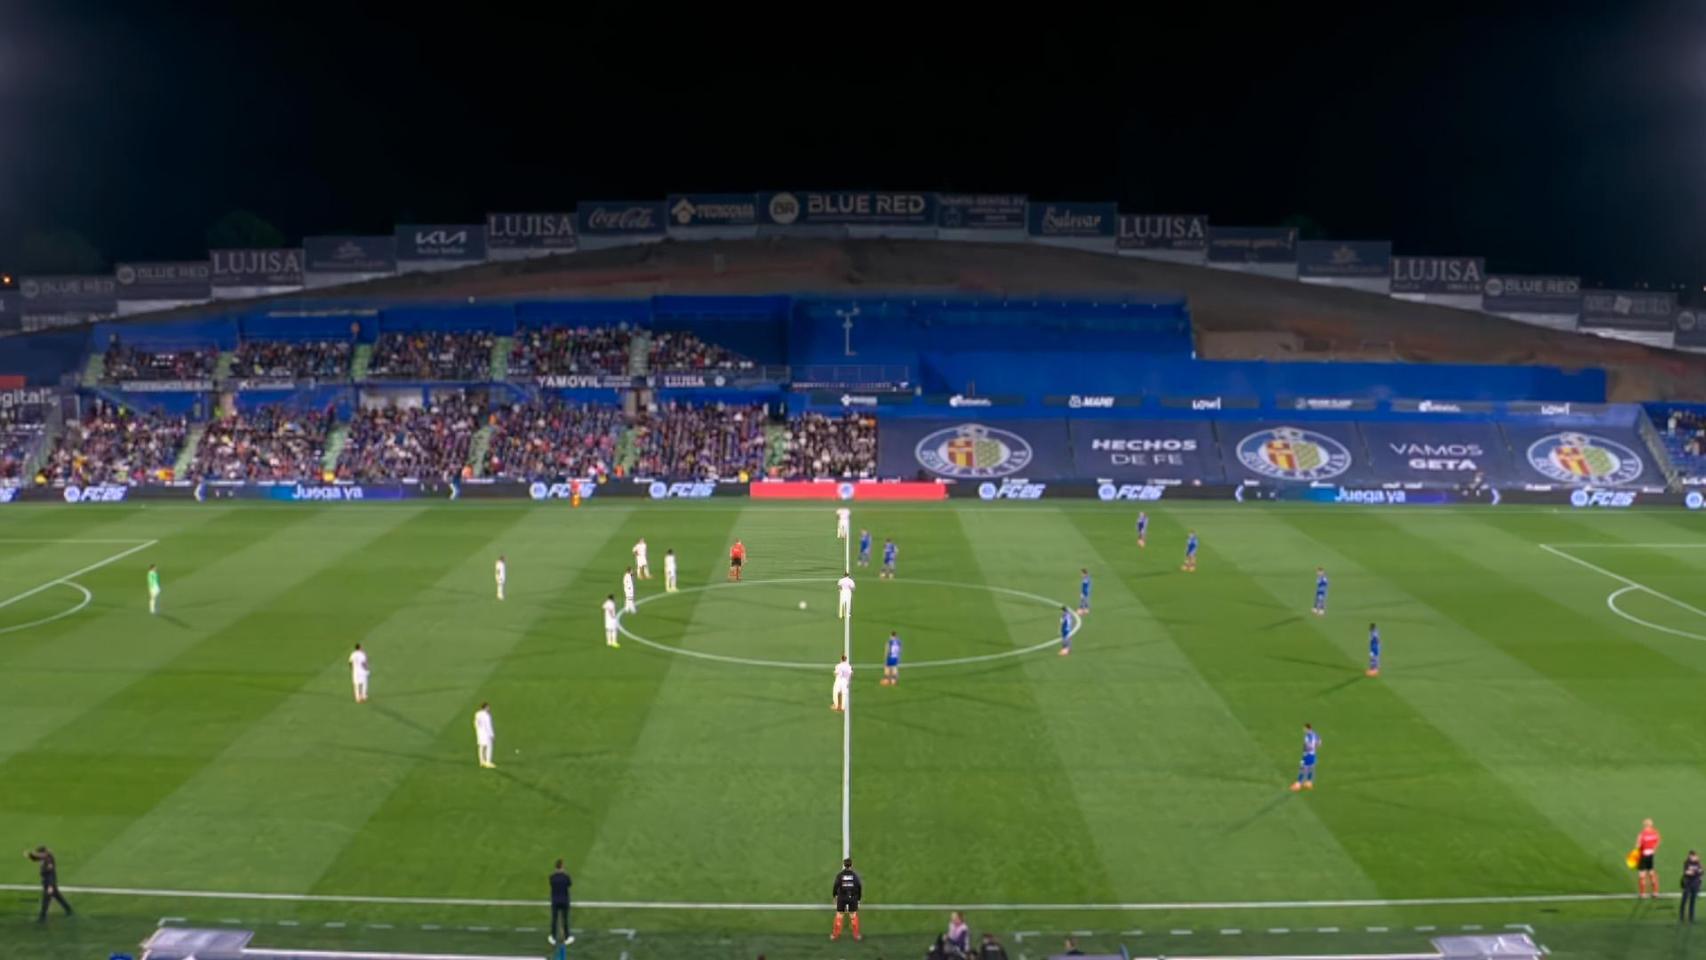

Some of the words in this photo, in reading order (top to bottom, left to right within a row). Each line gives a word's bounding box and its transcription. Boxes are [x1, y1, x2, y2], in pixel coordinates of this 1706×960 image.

[808, 194, 870, 214] BLUE
[876, 194, 926, 214] RED
[489, 215, 574, 236] LUJISA
[1119, 217, 1204, 238] LUJISA
[415, 231, 467, 245] KIA
[213, 252, 300, 274] LUJISA
[1393, 259, 1481, 281] LUJISA
[1504, 279, 1542, 293] BLUE
[1545, 279, 1578, 293] RED
[536, 376, 601, 388] YAMOVIL
[1091, 439, 1197, 450] HECHOS
[1390, 443, 1483, 456] VAMOS
[1111, 454, 1148, 465] DE
[1154, 454, 1183, 465] FE
[1409, 458, 1477, 470] GETA
[292, 485, 341, 500] Juega
[344, 489, 363, 501] ya
[1334, 486, 1384, 503] Juega
[1386, 490, 1406, 503] ya
